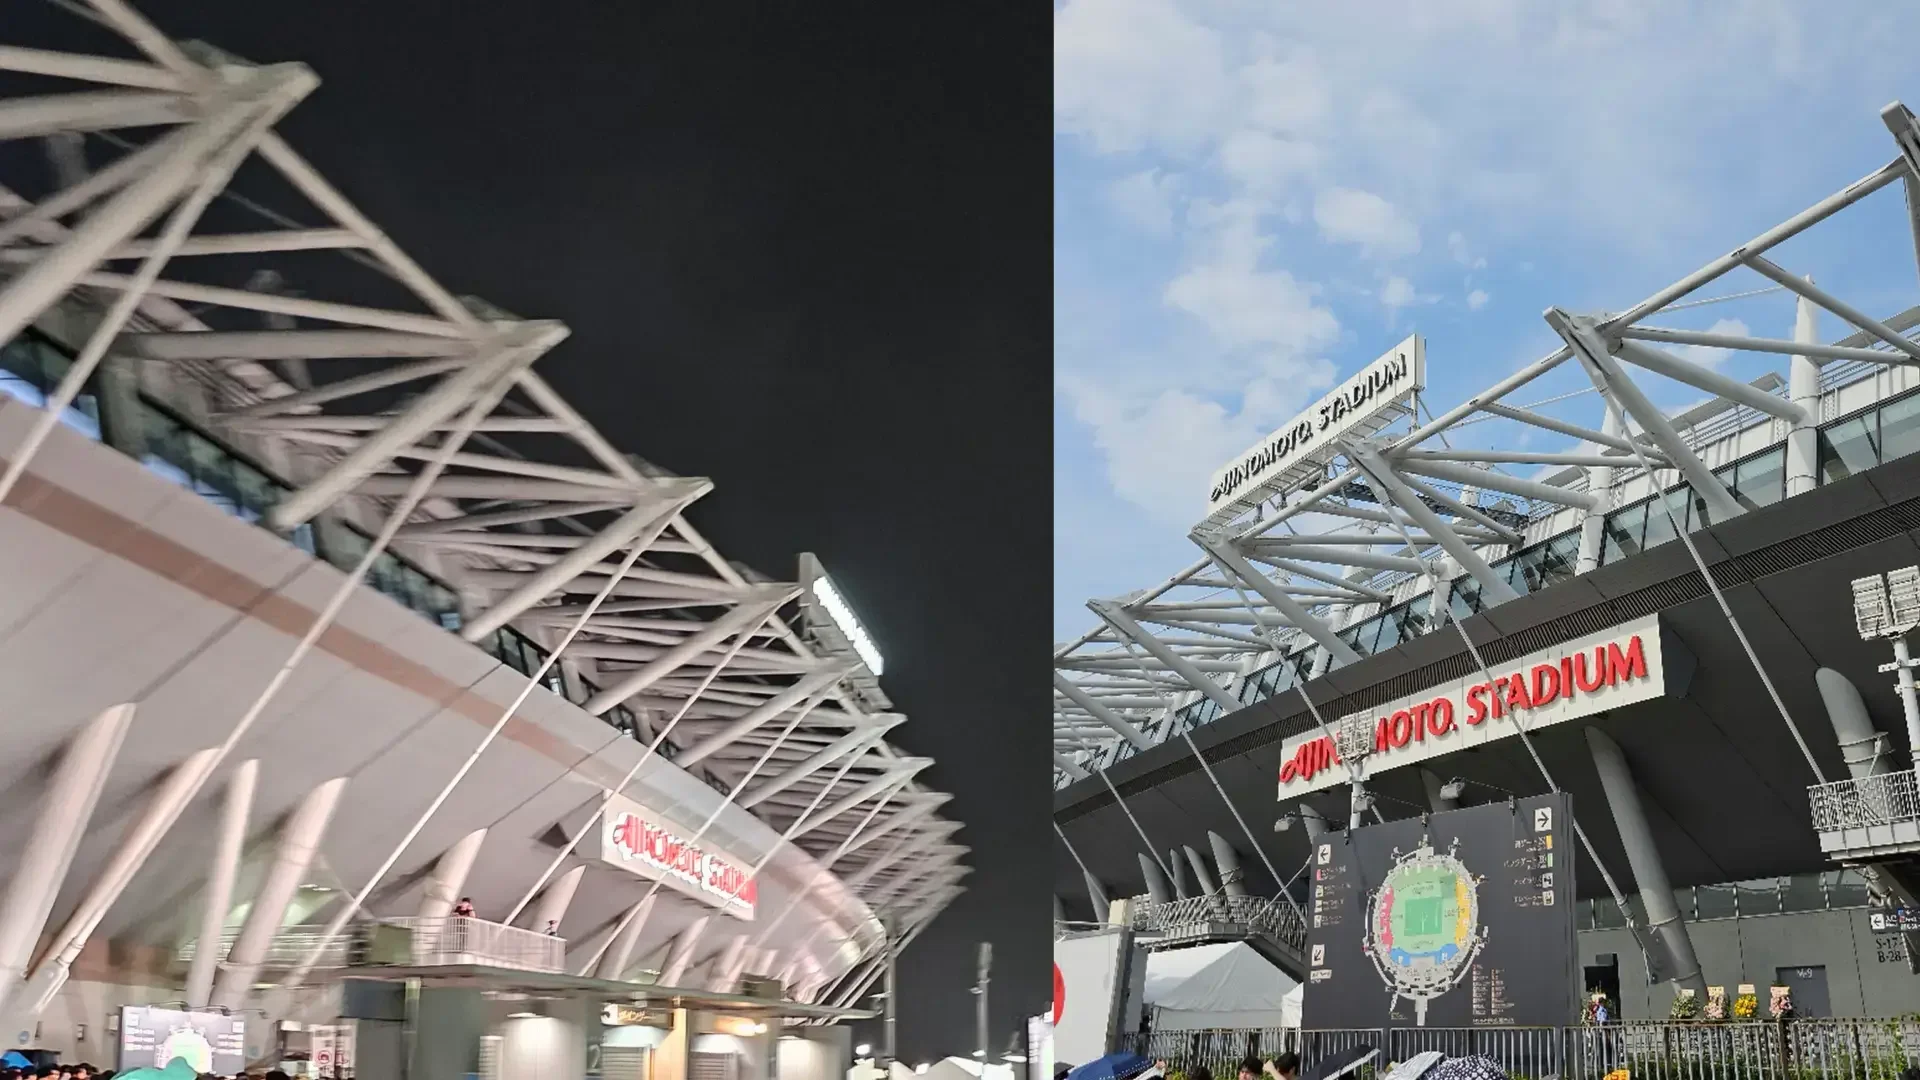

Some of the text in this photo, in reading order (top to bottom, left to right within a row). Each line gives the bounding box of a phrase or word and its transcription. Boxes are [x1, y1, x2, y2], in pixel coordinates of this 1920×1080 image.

[1317, 352, 1408, 431] STADIUM
[1278, 636, 1648, 783] AJINMOTO. STADIUM
